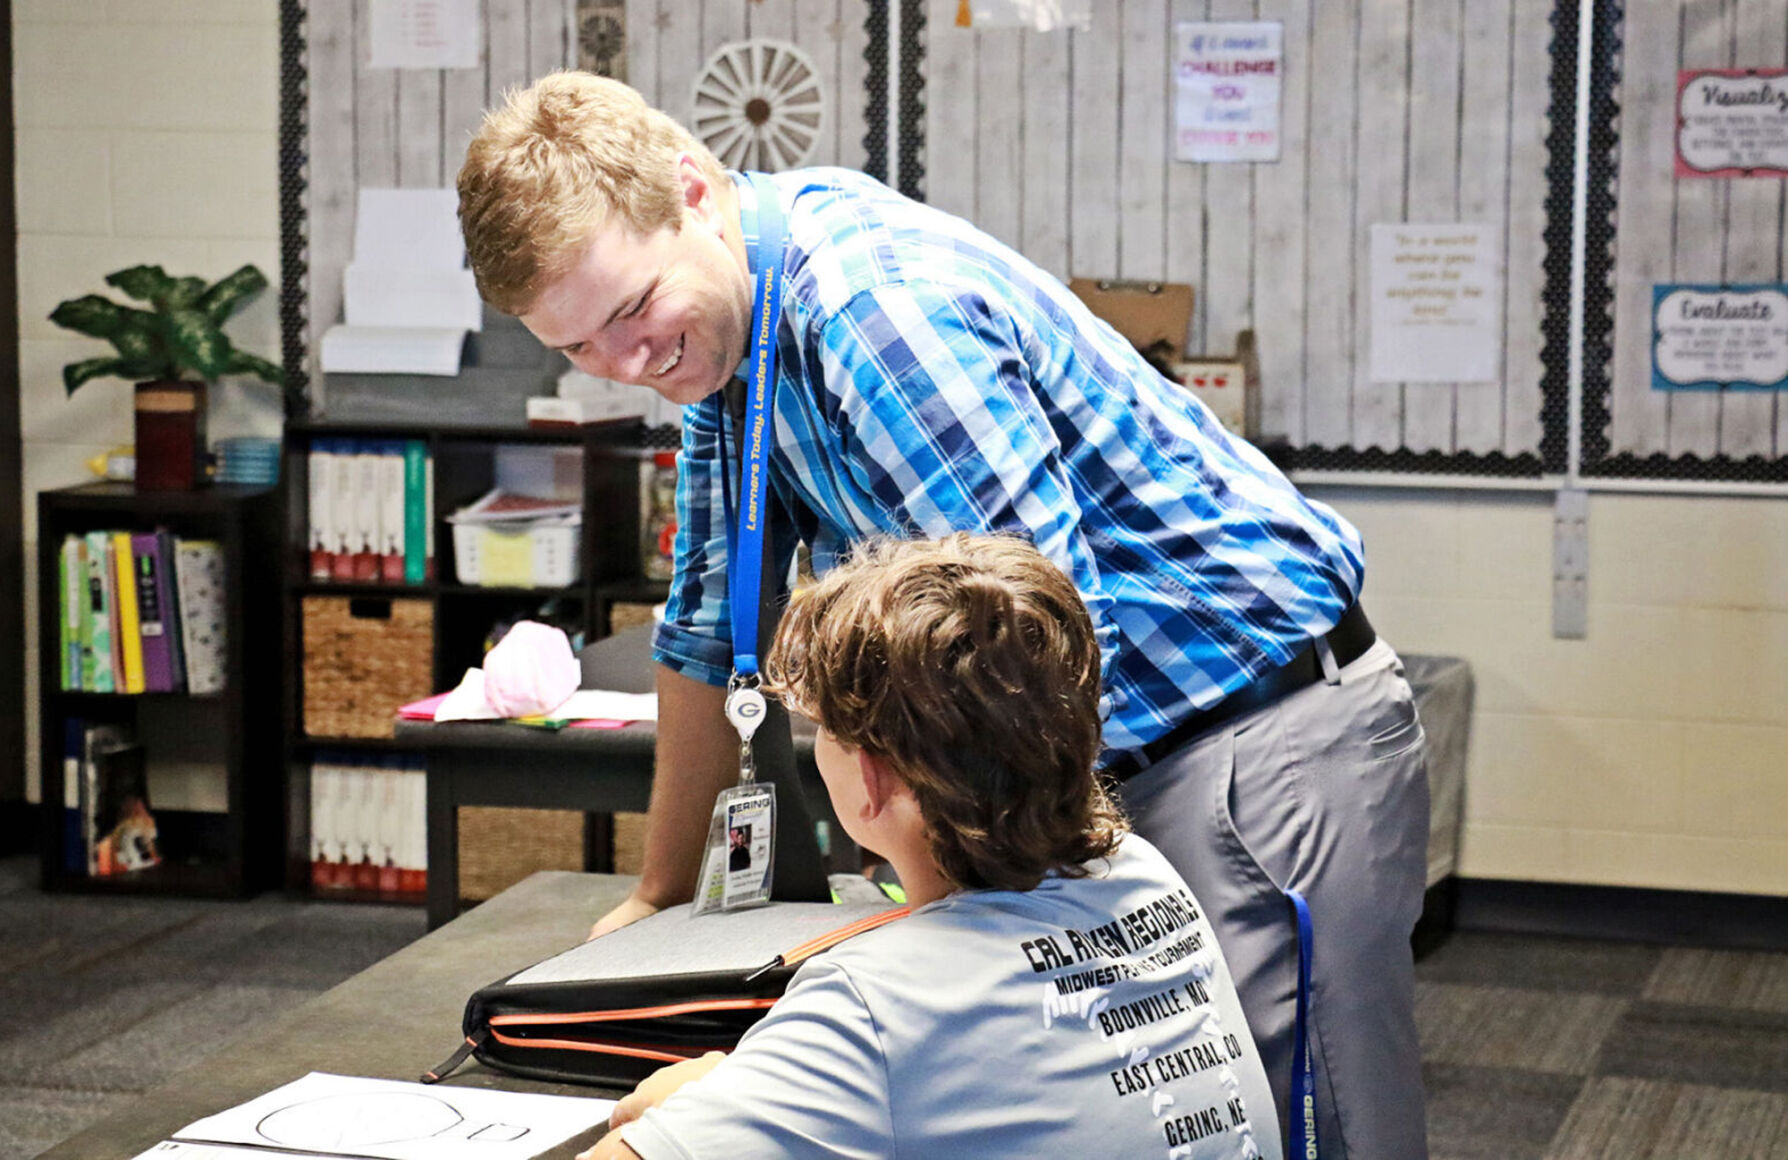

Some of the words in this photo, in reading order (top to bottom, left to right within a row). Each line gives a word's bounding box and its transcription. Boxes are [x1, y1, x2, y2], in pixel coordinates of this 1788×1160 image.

[1682, 298, 1775, 320] Evaluate
[746, 463, 761, 531] Learners
[754, 349, 768, 410] Leaders
[737, 702, 761, 718] G
[728, 798, 770, 814] GERING
[1020, 935, 1074, 973] CAL
[1054, 964, 1121, 996] MIDWEST
[1097, 988, 1190, 1037] BOONVILLE,
[1184, 980, 1209, 1007] MO
[1110, 1062, 1155, 1096] EAST
[1155, 1041, 1228, 1082] CENTRAL,
[1223, 1033, 1242, 1060] CO
[1227, 1097, 1246, 1127] NE
[1303, 1094, 1318, 1160] GERING
